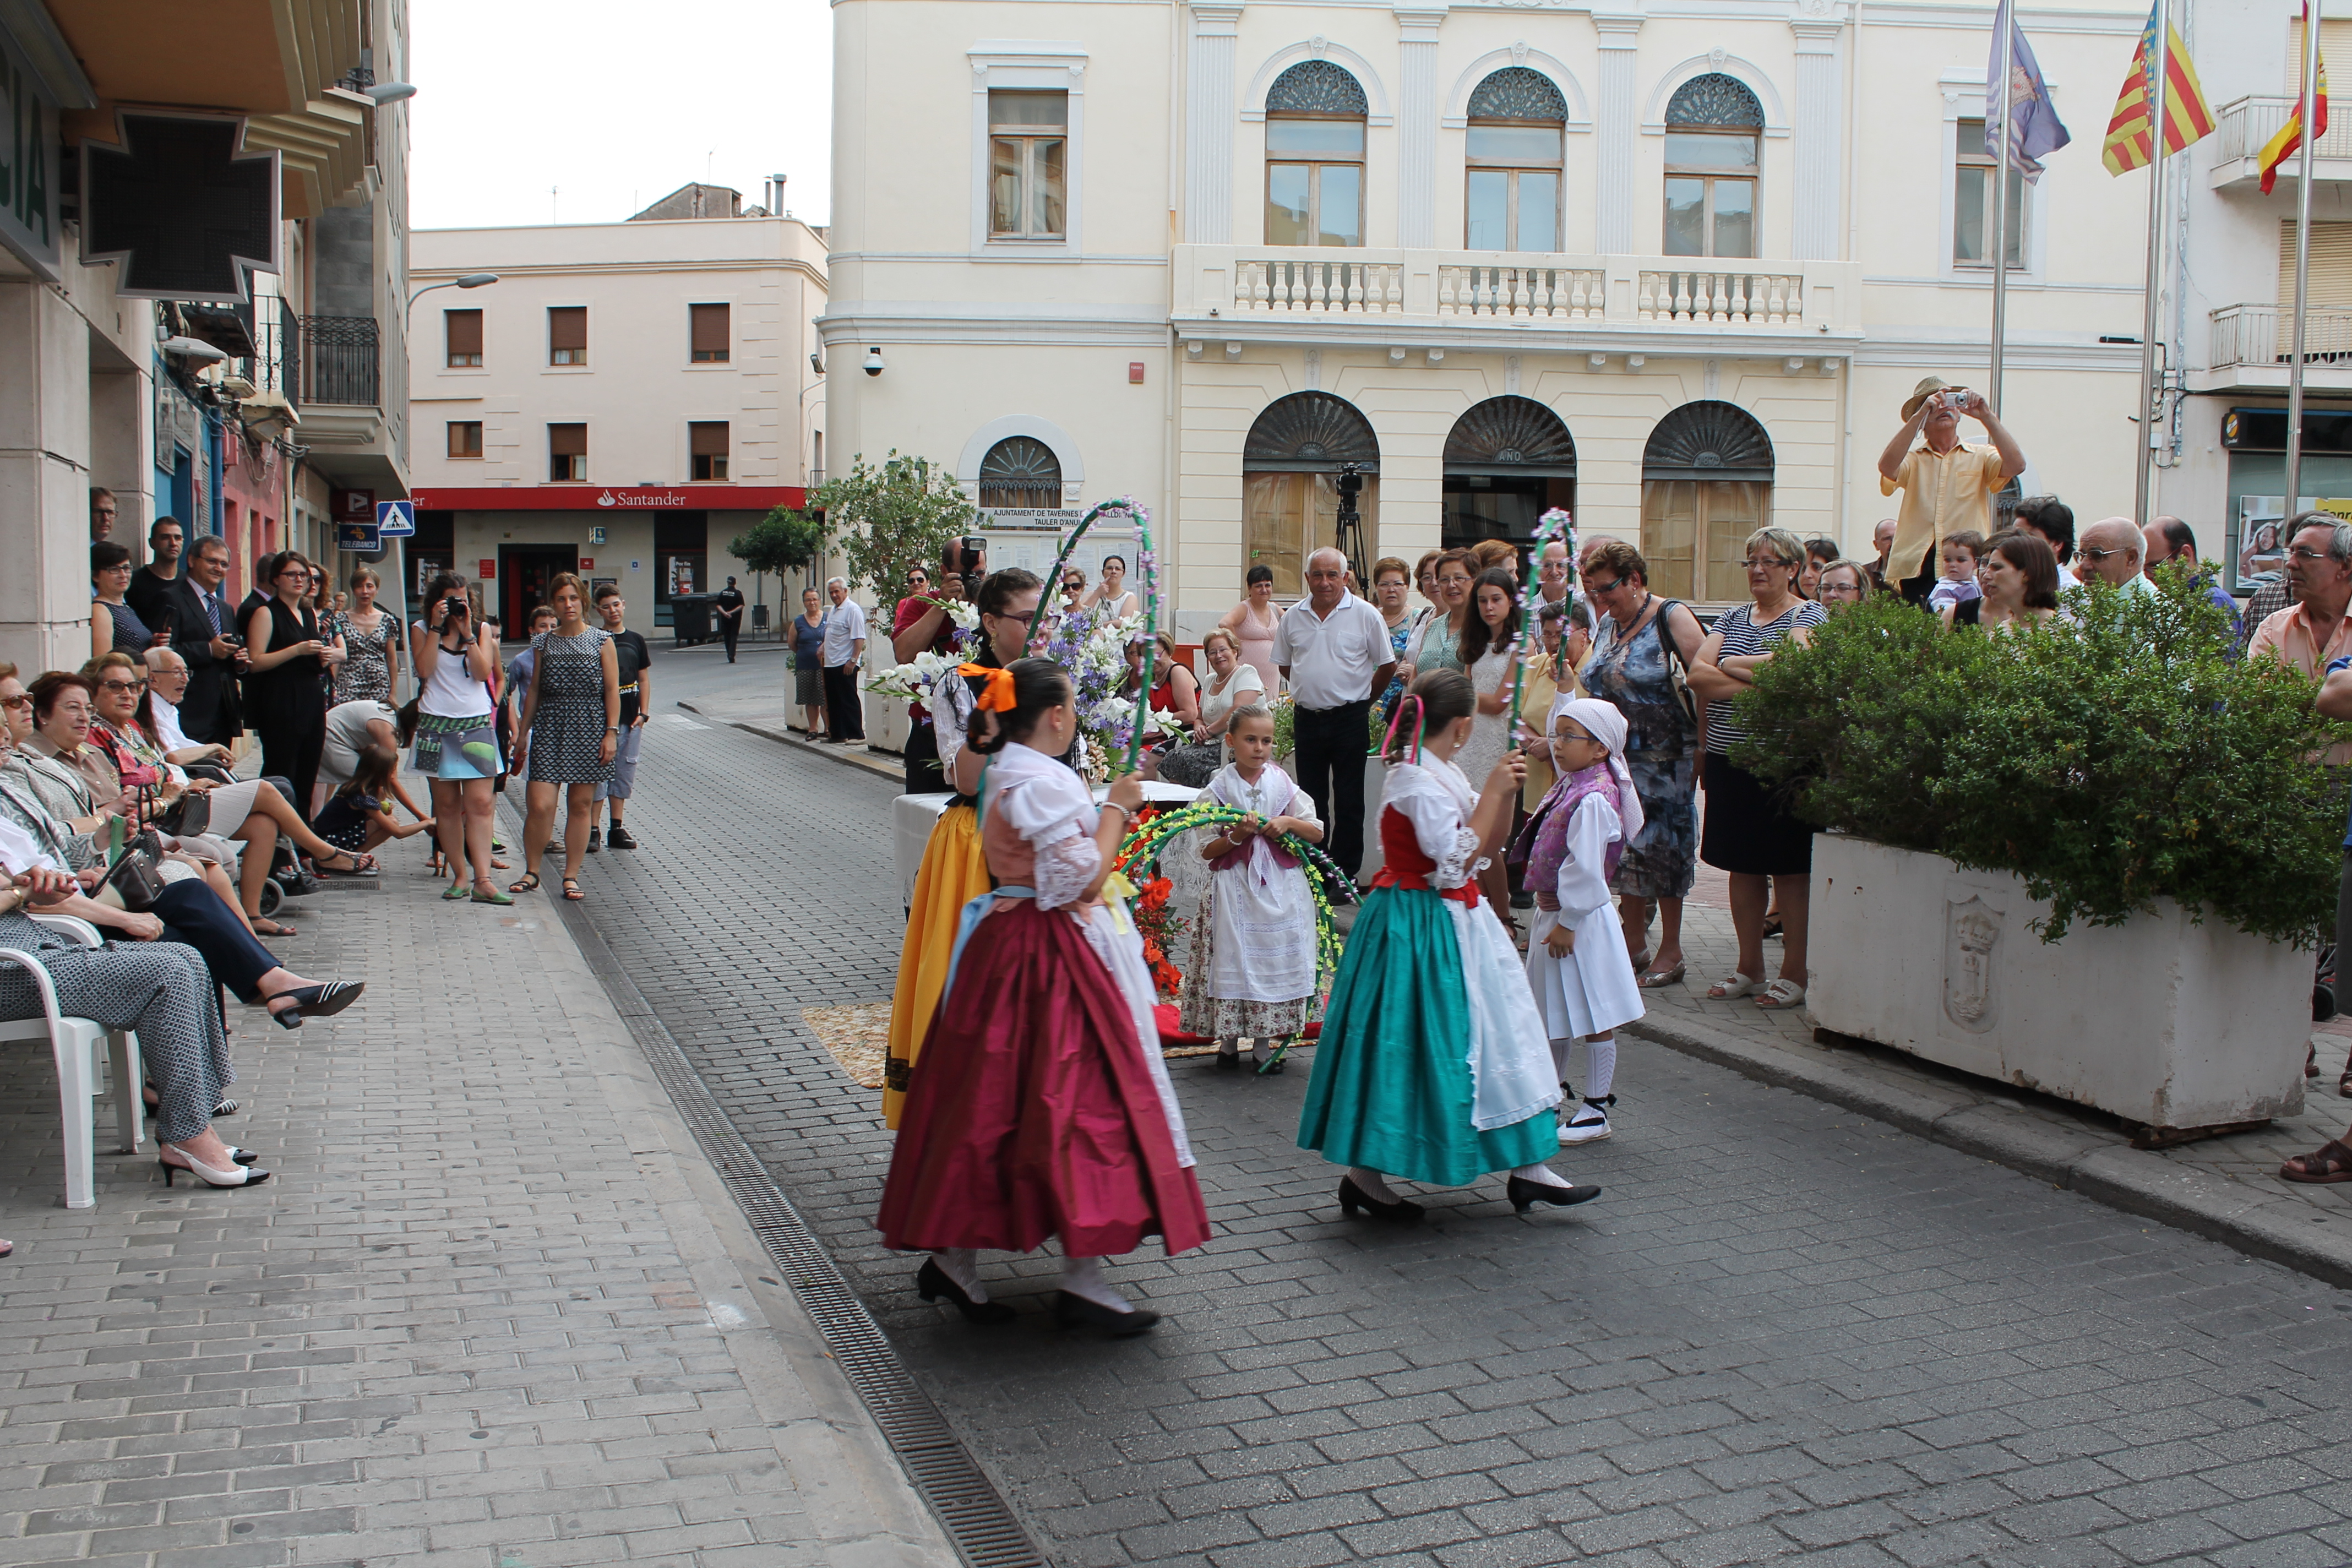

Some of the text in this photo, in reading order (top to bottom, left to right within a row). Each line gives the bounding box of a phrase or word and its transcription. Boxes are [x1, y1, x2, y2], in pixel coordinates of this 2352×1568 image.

[1499, 448, 1520, 461] AÑO
[618, 491, 686, 505] Santander
[341, 540, 377, 548] TELEBANCO
